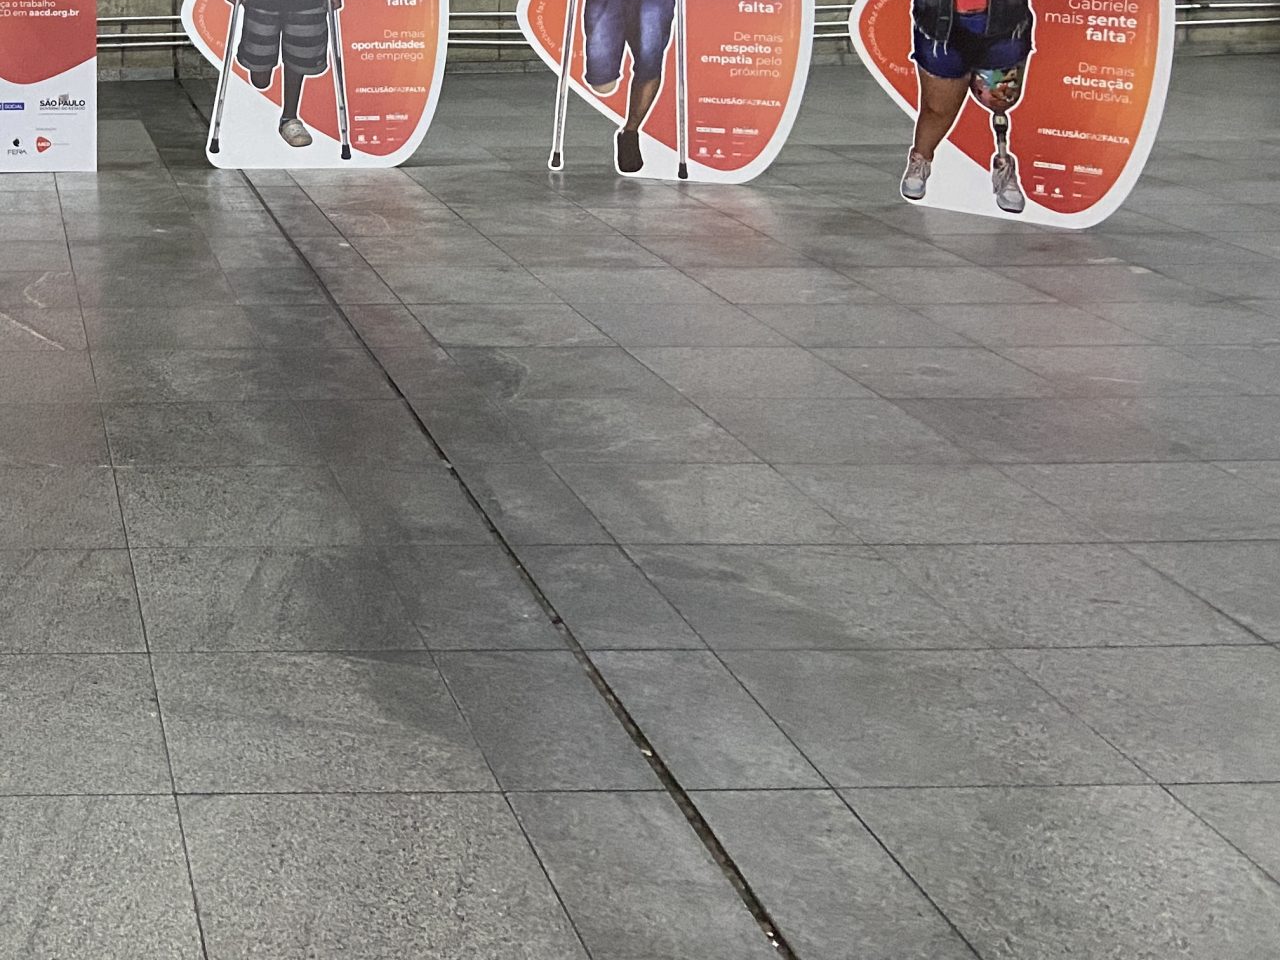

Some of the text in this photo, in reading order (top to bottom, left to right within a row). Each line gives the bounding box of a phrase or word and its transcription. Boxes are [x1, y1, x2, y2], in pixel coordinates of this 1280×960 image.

[20, 0, 56, 8] trabalho
[738, 1, 782, 14] falta?
[29, 9, 80, 18] aacd.org.br
[1045, 12, 1138, 28] mais sente
[384, 30, 425, 38] De mais
[734, 32, 783, 43] De mais
[1086, 28, 1136, 45] falta?
[352, 40, 425, 51] oportunidades
[720, 43, 782, 54] respeito e
[361, 52, 374, 60] de
[700, 55, 782, 66] empatia pelo
[1078, 62, 1135, 77] De mais
[1063, 75, 1134, 92] educação
[1072, 88, 1132, 104] inclusiva.
[40, 98, 86, 106] SÃO PAULO
